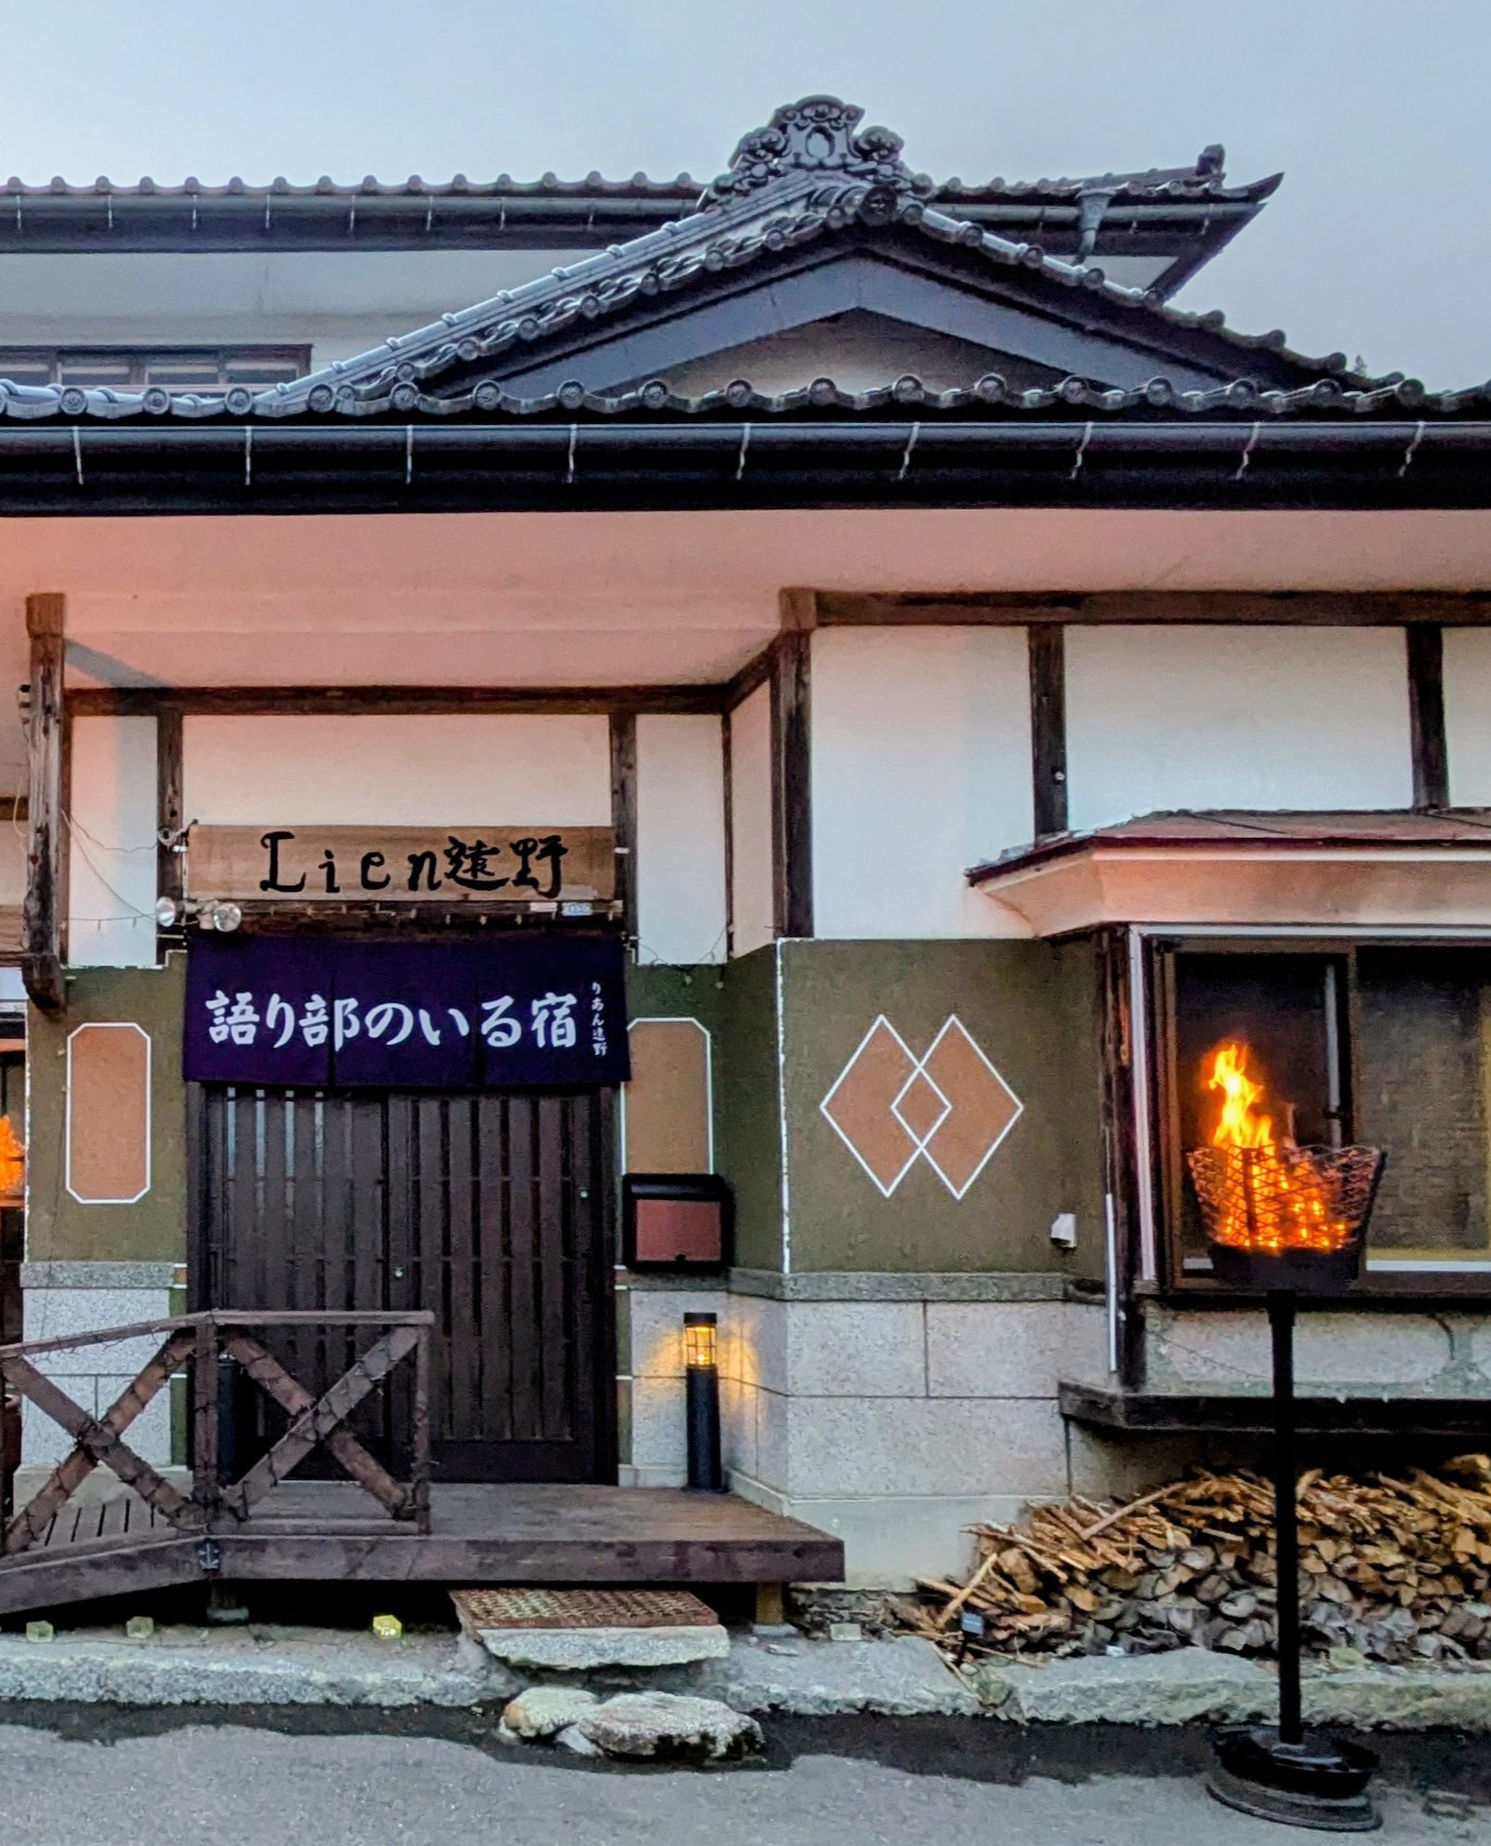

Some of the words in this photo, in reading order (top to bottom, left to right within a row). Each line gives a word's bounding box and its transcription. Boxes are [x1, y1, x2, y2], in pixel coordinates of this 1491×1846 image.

[205, 989, 577, 1052] 語り部のいる宿
[591, 981, 608, 1056] りあん遠野
